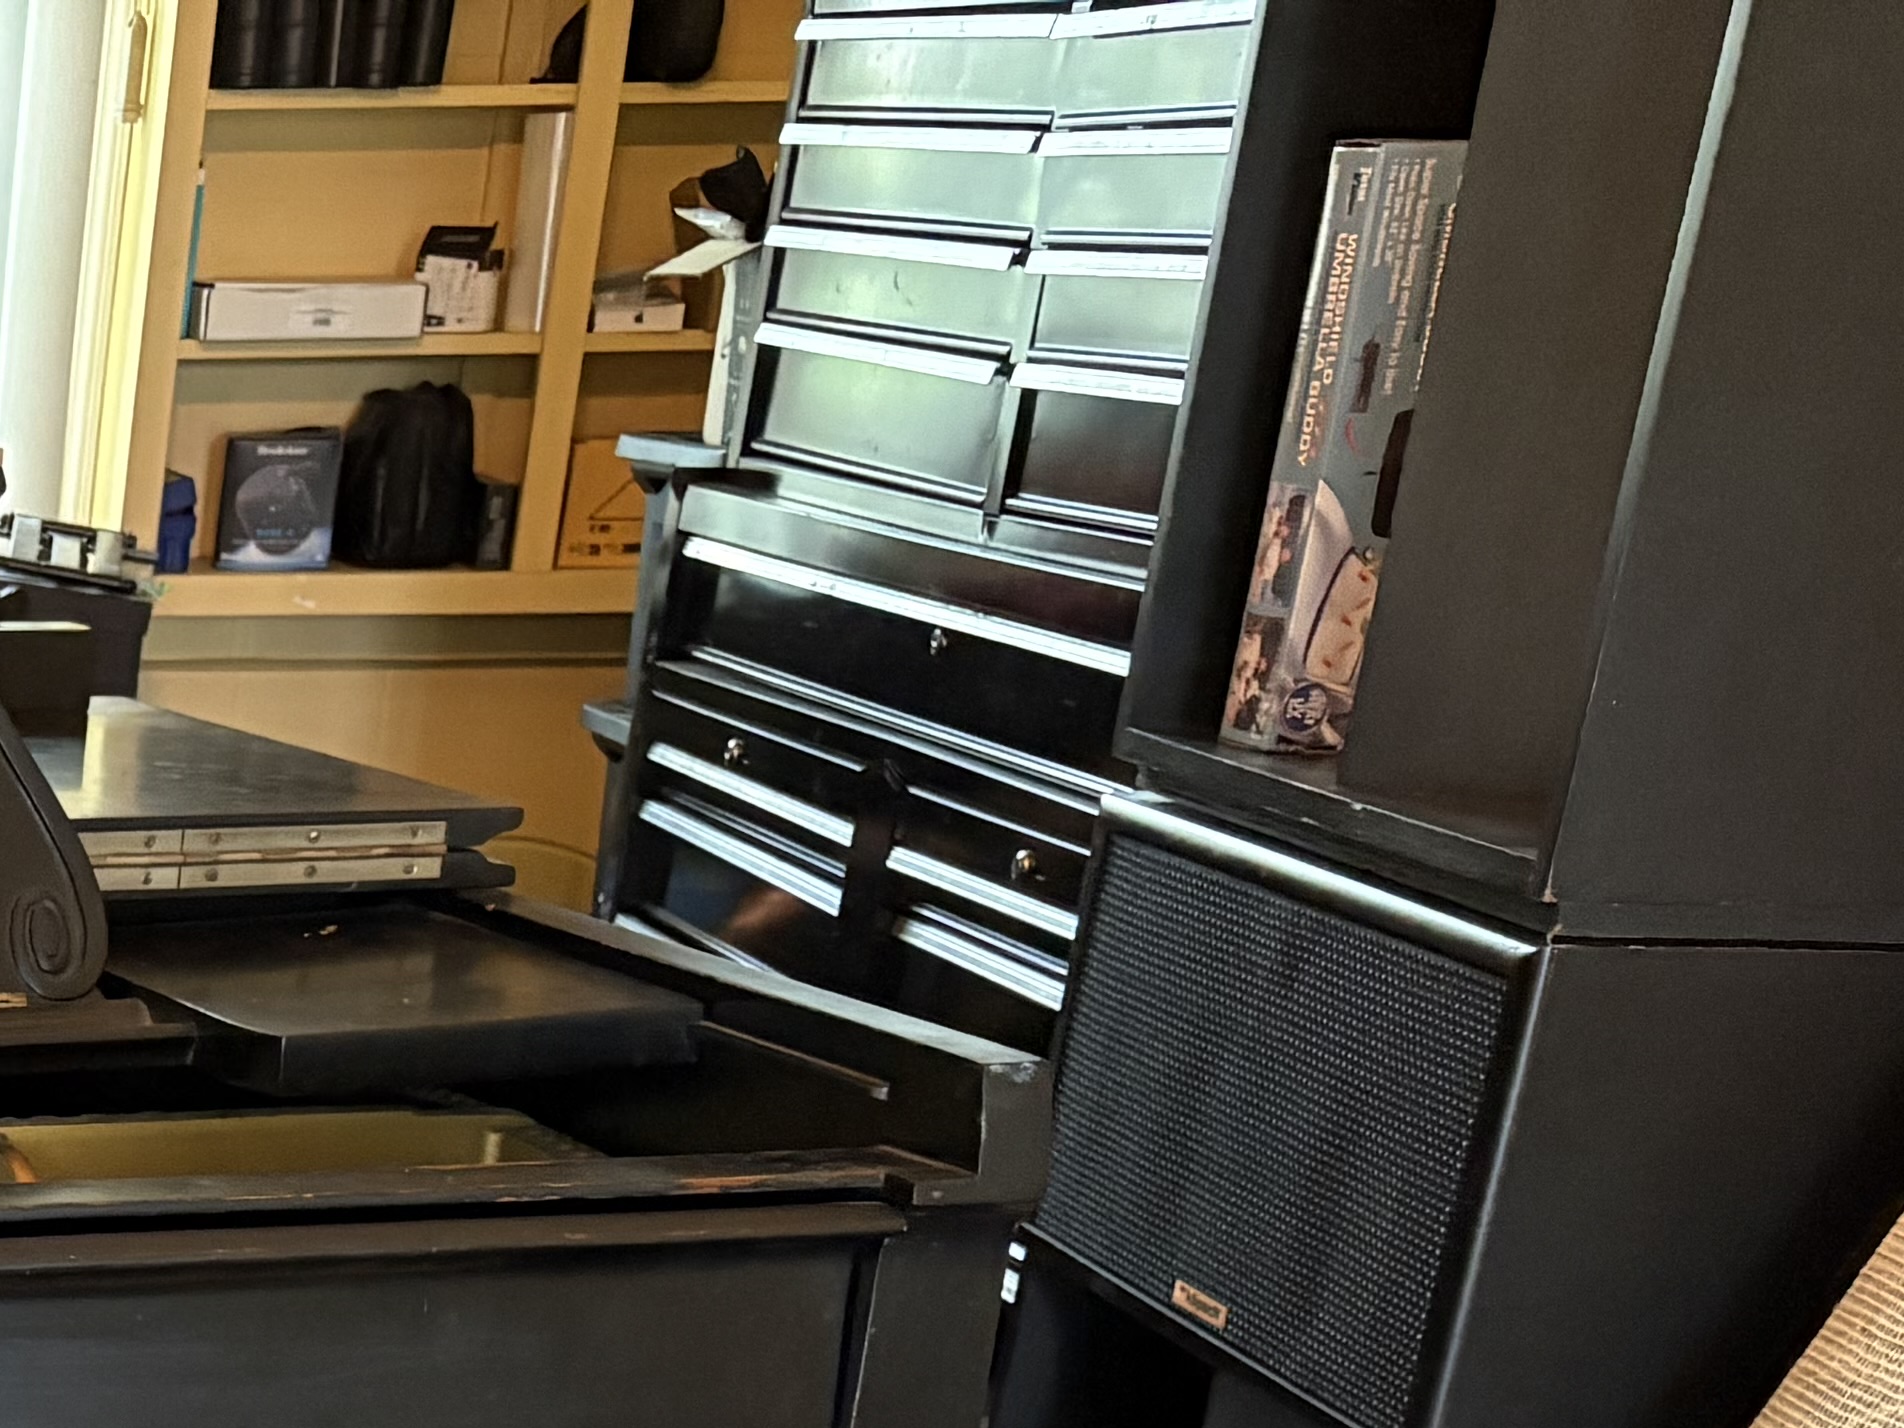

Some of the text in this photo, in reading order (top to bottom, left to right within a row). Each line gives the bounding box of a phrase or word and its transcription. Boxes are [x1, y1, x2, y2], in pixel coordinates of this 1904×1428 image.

[1312, 232, 1349, 371] UMBRELLA
[1323, 233, 1359, 385] WINDSHIELD
[1298, 380, 1322, 466] BUDDY
